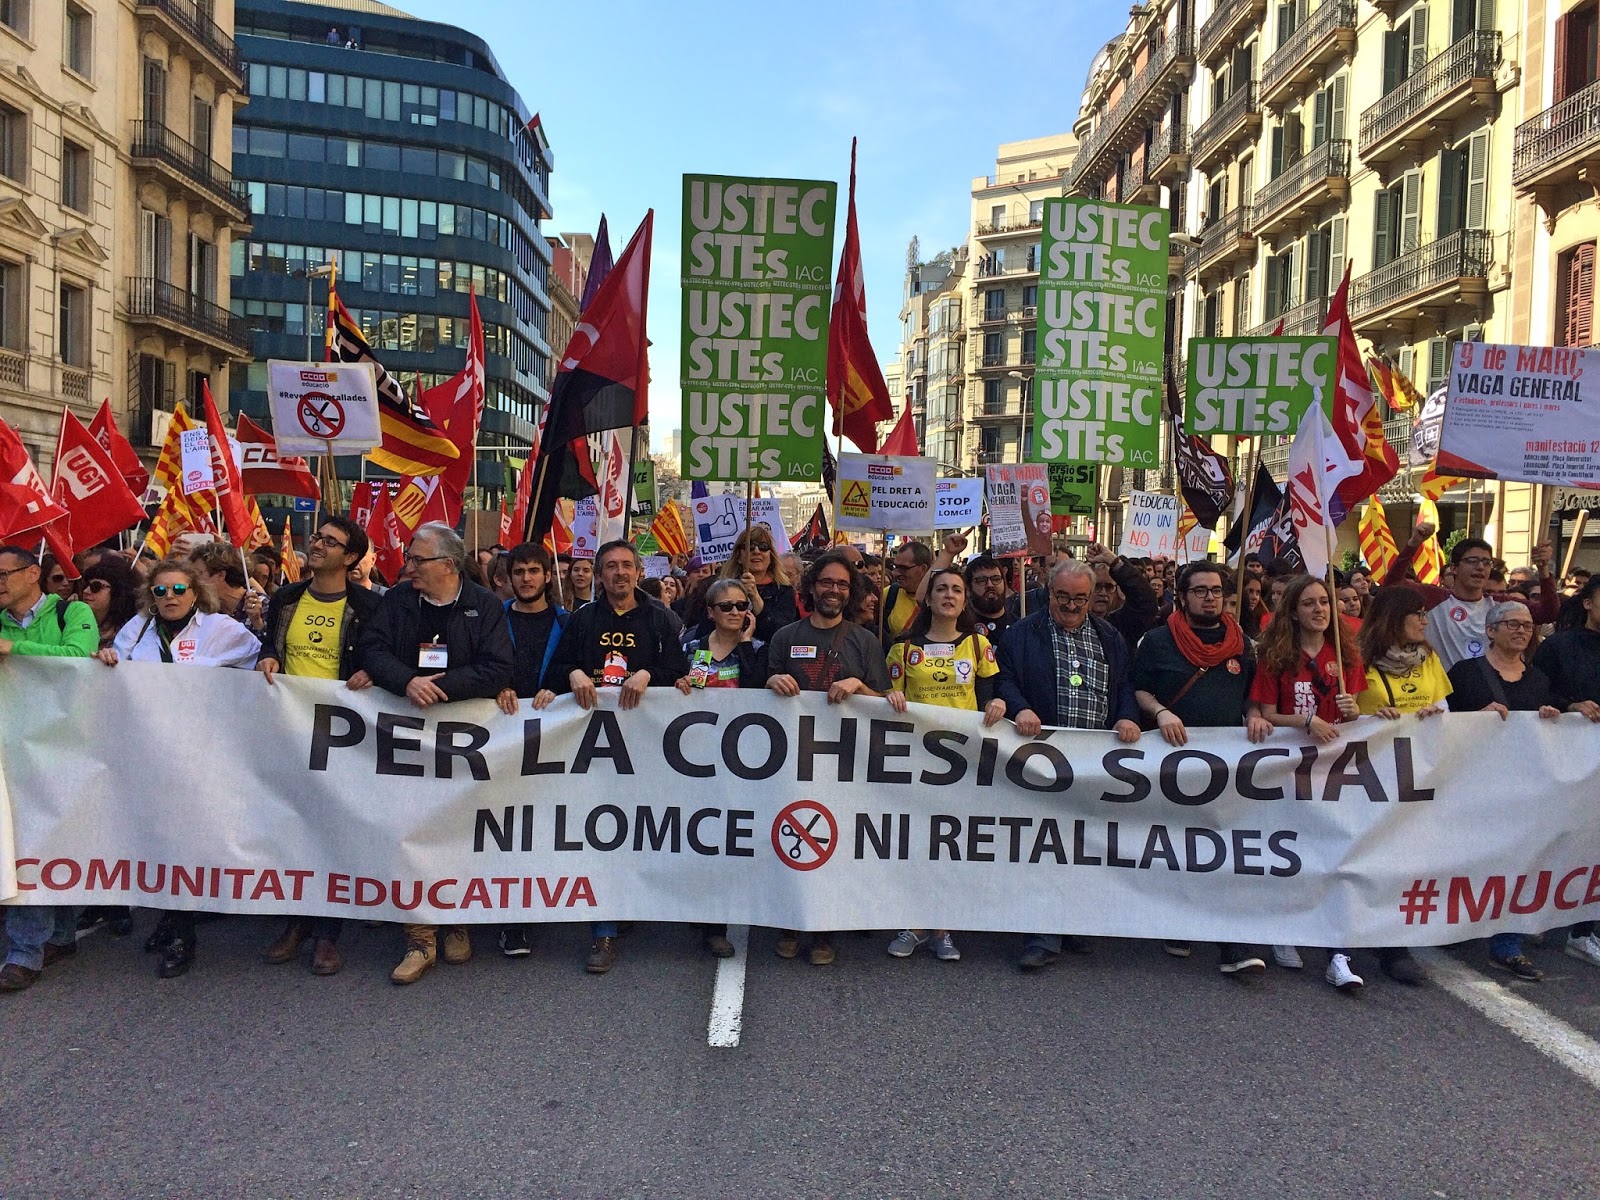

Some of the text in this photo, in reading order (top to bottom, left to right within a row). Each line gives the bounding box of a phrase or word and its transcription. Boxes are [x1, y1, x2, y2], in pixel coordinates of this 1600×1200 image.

[690, 181, 827, 237] USTEC
[1049, 203, 1162, 251] USTEC
[690, 232, 824, 282] STEs IAC
[1047, 242, 1130, 283] STEs
[1136, 273, 1161, 287] IAC
[689, 290, 821, 341] USTEC
[1044, 290, 1157, 338] USTEC
[689, 337, 818, 383] STEs IAC
[1042, 329, 1127, 373] STEs
[1460, 341, 1586, 380] 9 de MARÇ
[1196, 342, 1329, 388] USTEC
[1458, 373, 1582, 402] VAGA GENERAL
[1041, 378, 1153, 425] USTEC
[1194, 388, 1290, 432] STEs
[1544, 403, 1560, 411] mares
[689, 392, 817, 438] USTEC
[1040, 420, 1153, 464] STEs IAC
[1526, 440, 1586, 453] manifestació
[689, 436, 815, 479] STEs IAC
[67, 452, 106, 493] UGT
[1000, 467, 1011, 481] de
[1076, 465, 1095, 484] Sí
[187, 482, 200, 491] NO
[872, 486, 888, 494] PEL
[889, 487, 912, 495] DRET
[990, 482, 1016, 495] VAGA
[871, 499, 928, 509] L'EDUCACIÓ!
[939, 497, 970, 506] STOP
[990, 495, 1018, 506] GENERAL
[1132, 494, 1177, 511] L'EDUCACI
[938, 509, 972, 517] LOMCE!
[1133, 511, 1172, 528] NO UN
[701, 542, 736, 556] LOMC
[1129, 530, 1150, 547] NO
[1158, 534, 1168, 550] A
[702, 555, 713, 563] No
[304, 614, 336, 628] SOS
[181, 640, 196, 648] UGT
[599, 631, 636, 648] S.O.S.
[925, 658, 955, 668] SOS
[604, 674, 624, 685] CGT
[1294, 681, 1313, 694] RE
[1294, 693, 1316, 706] SIS
[308, 703, 1435, 806] PER LA COHESIÓ SOCIAL
[472, 803, 1302, 878] NI LOMCE NI RETALLADES
[15, 858, 598, 911] COMUNITAT EDUCATIVA
